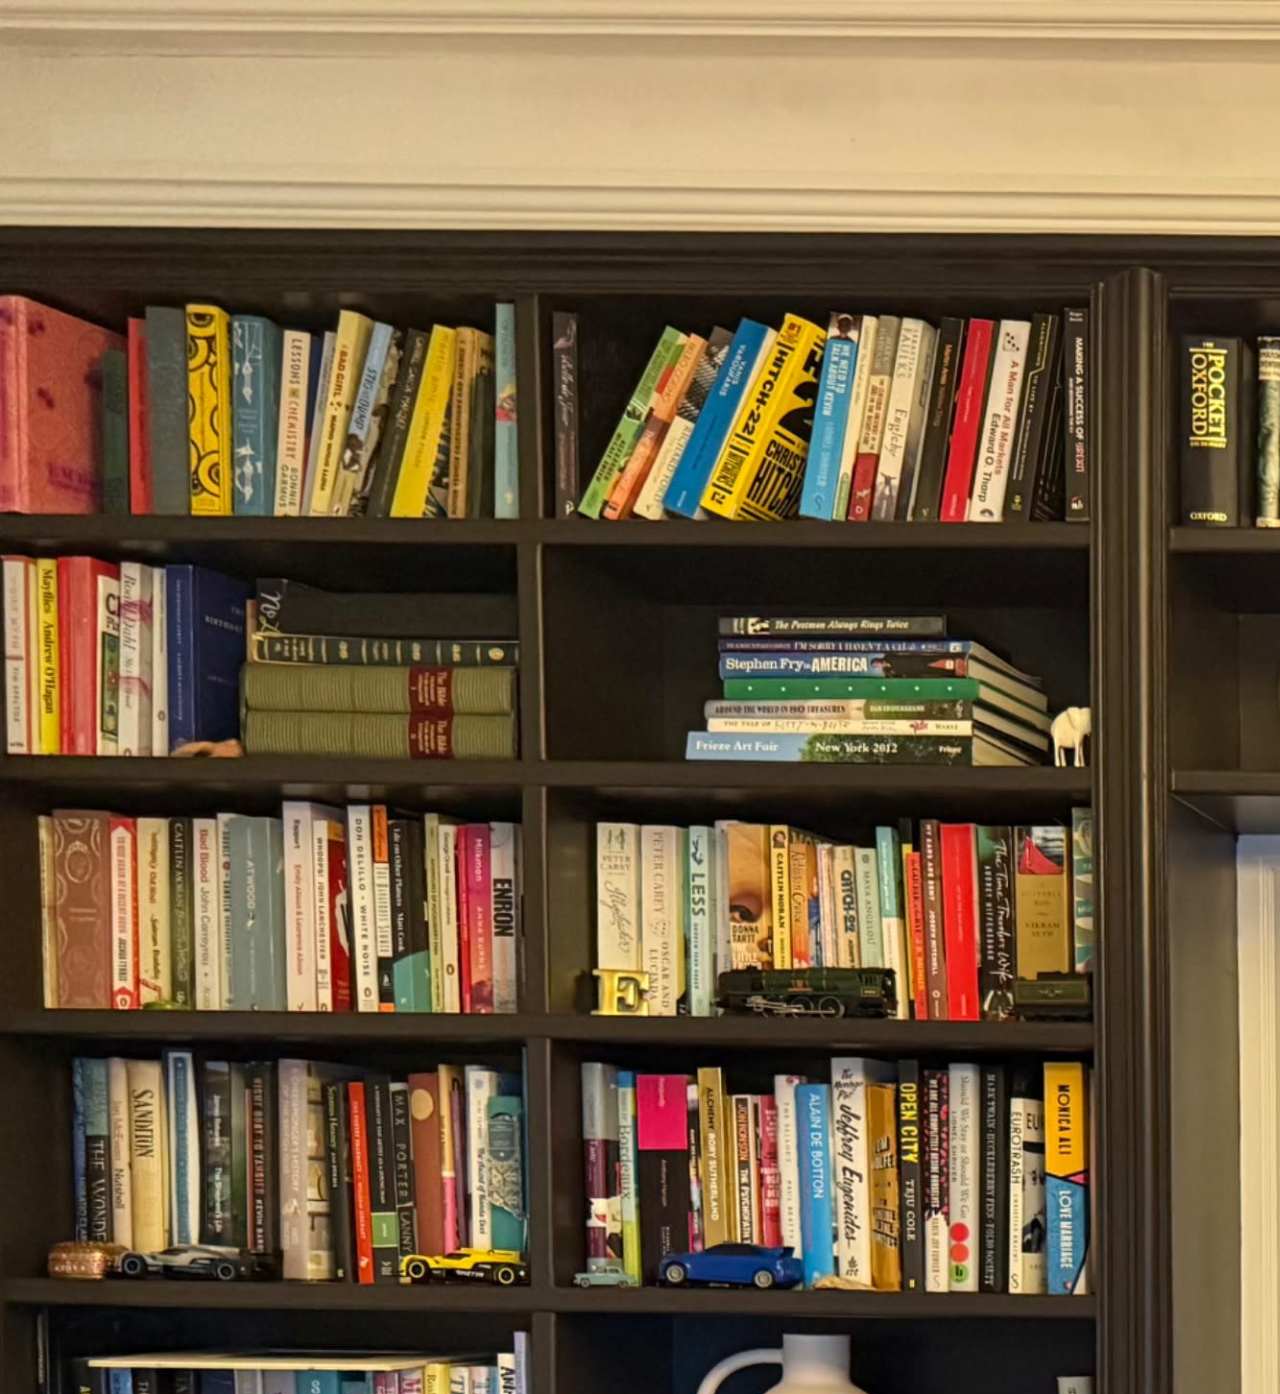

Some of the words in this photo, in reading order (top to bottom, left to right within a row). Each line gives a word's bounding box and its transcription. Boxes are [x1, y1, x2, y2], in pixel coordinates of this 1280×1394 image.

[741, 347, 789, 437] HITCH-22
[1191, 353, 1208, 435] OXFORD
[1208, 354, 1226, 436] POCKET
[986, 413, 1000, 453] Edward
[978, 471, 992, 502] Thorp
[41, 569, 55, 614] Mayflies
[43, 621, 55, 664] Andrew
[726, 659, 778, 672] Stephen
[780, 658, 803, 672] Fry
[812, 657, 868, 672] AMERICA
[44, 667, 56, 714] O'Hagan
[696, 741, 731, 750] Frieze
[733, 741, 752, 750] Art
[755, 741, 779, 750] Fair
[815, 742, 839, 752] New
[844, 742, 869, 753] York
[873, 742, 898, 753] 2012
[200, 853, 210, 882] Blood
[357, 846, 366, 891] DELILLO
[653, 832, 664, 871] PETER
[247, 860, 255, 909] ATWOOD
[653, 873, 665, 914] CAREY
[691, 873, 705, 917] LESS
[360, 905, 368, 941] WHITE
[493, 878, 513, 937] ENRON
[591, 969, 650, 1016] E
[395, 1095, 404, 1125] MAX
[706, 1087, 714, 1130] ALCHEMY
[809, 1093, 821, 1128] ALAIN
[900, 1083, 918, 1121] OPEN
[1057, 1084, 1070, 1132] MONICA
[132, 1090, 154, 1158] SANDITON
[708, 1133, 718, 1157] RORY
[810, 1132, 822, 1147] DE
[839, 1104, 860, 1162] Jeffrey
[901, 1126, 918, 1164] CITY
[619, 1125, 632, 1200] Bordeaux
[1011, 1112, 1022, 1184] EUROTRASH
[1059, 1137, 1071, 1155] ALI
[397, 1144, 408, 1199] PORTER
[709, 1160, 719, 1221] SUTHERLAND
[740, 1168, 748, 1184] THE
[811, 1150, 824, 1199] BOTTON
[841, 1166, 863, 1241] Eugenides
[905, 1179, 915, 1208] TEJU
[1059, 1191, 1072, 1219] LOVE
[401, 1212, 412, 1252] LANNY
[906, 1211, 916, 1241] COLE
[1060, 1221, 1073, 1269] MARRIAGE
